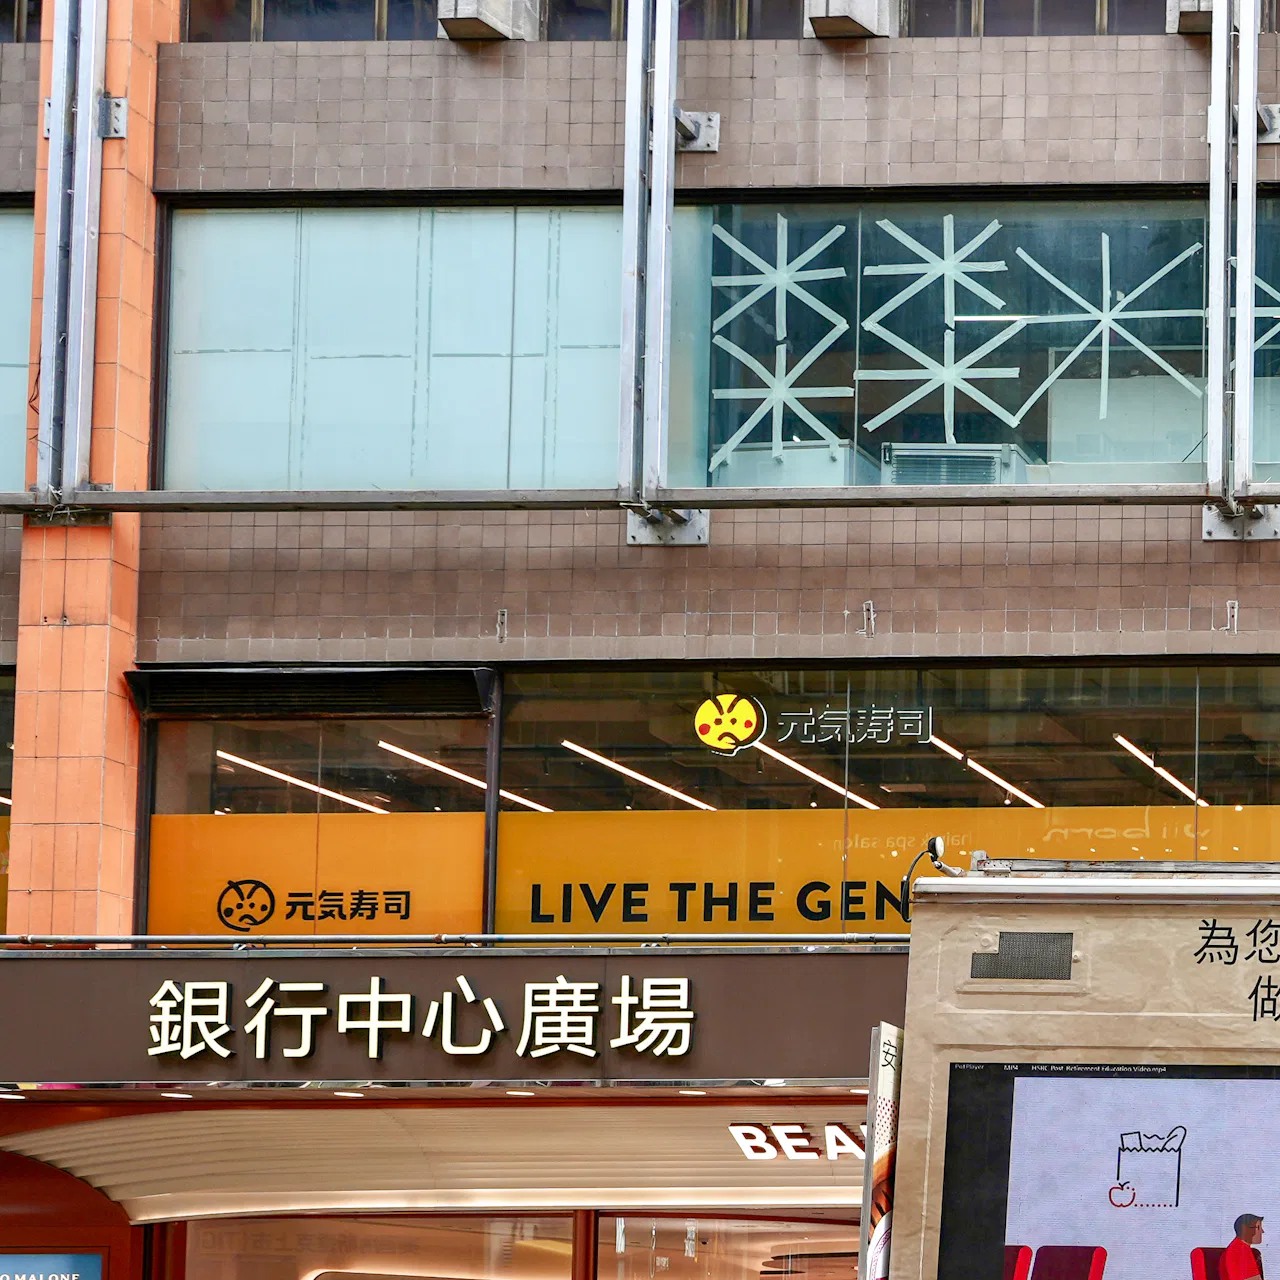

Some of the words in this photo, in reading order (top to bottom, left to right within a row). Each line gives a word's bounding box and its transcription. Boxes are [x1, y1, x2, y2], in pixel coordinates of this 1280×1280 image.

[777, 703, 934, 744] 元気寿司
[285, 889, 411, 920] 元気寿司
[531, 882, 649, 924] LIVE
[669, 881, 776, 923] THE
[147, 975, 696, 1060] 銀行中心廣場
